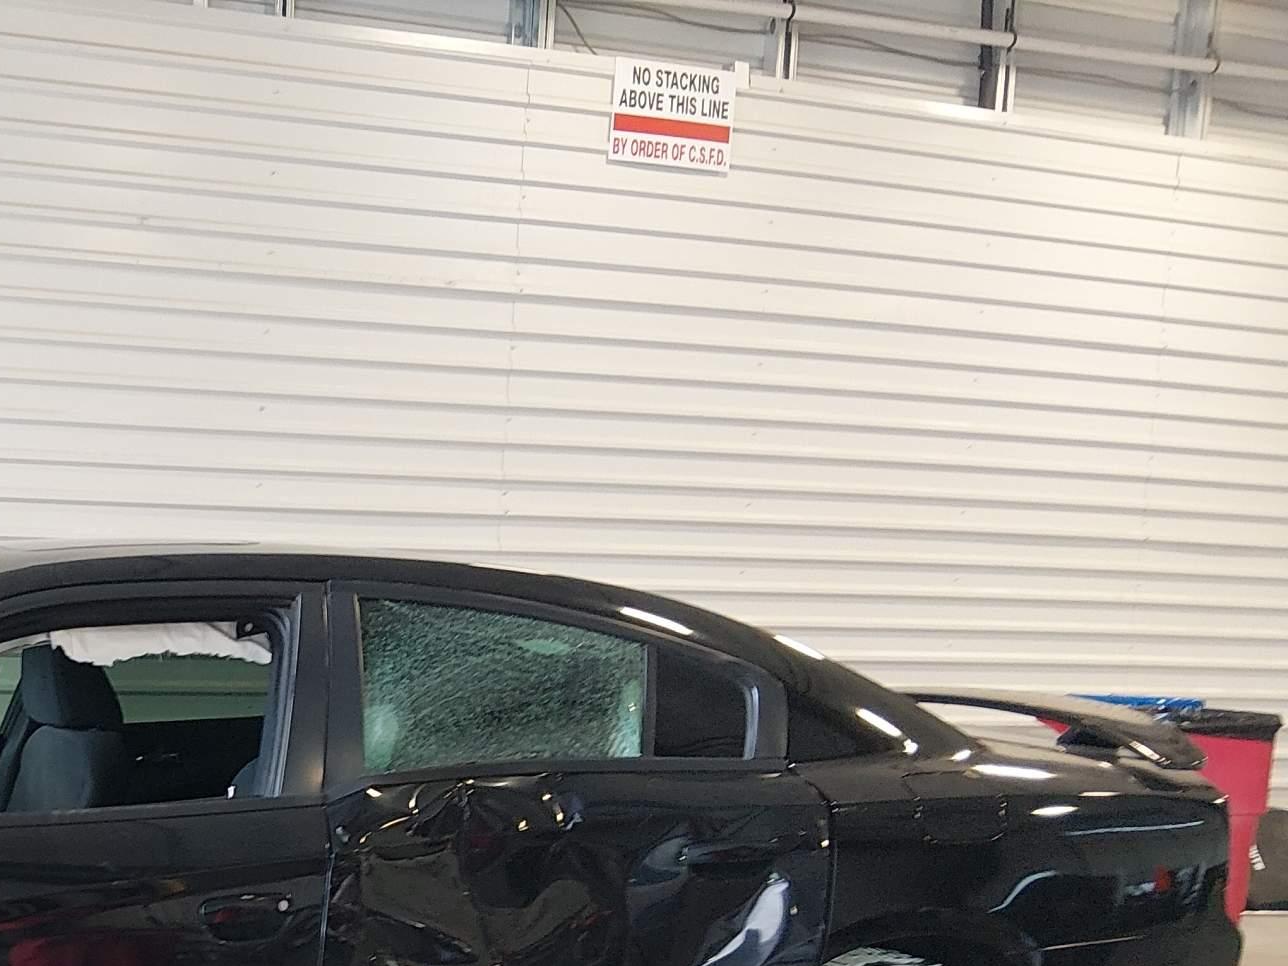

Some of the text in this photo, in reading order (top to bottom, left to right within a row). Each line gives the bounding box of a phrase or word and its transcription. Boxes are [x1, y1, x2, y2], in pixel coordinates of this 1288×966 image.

[632, 65, 720, 95] NO STACKING
[619, 88, 729, 120] ABOVE THIS LINE
[612, 137, 727, 167] BY ORDER OF C.S.F.D.
